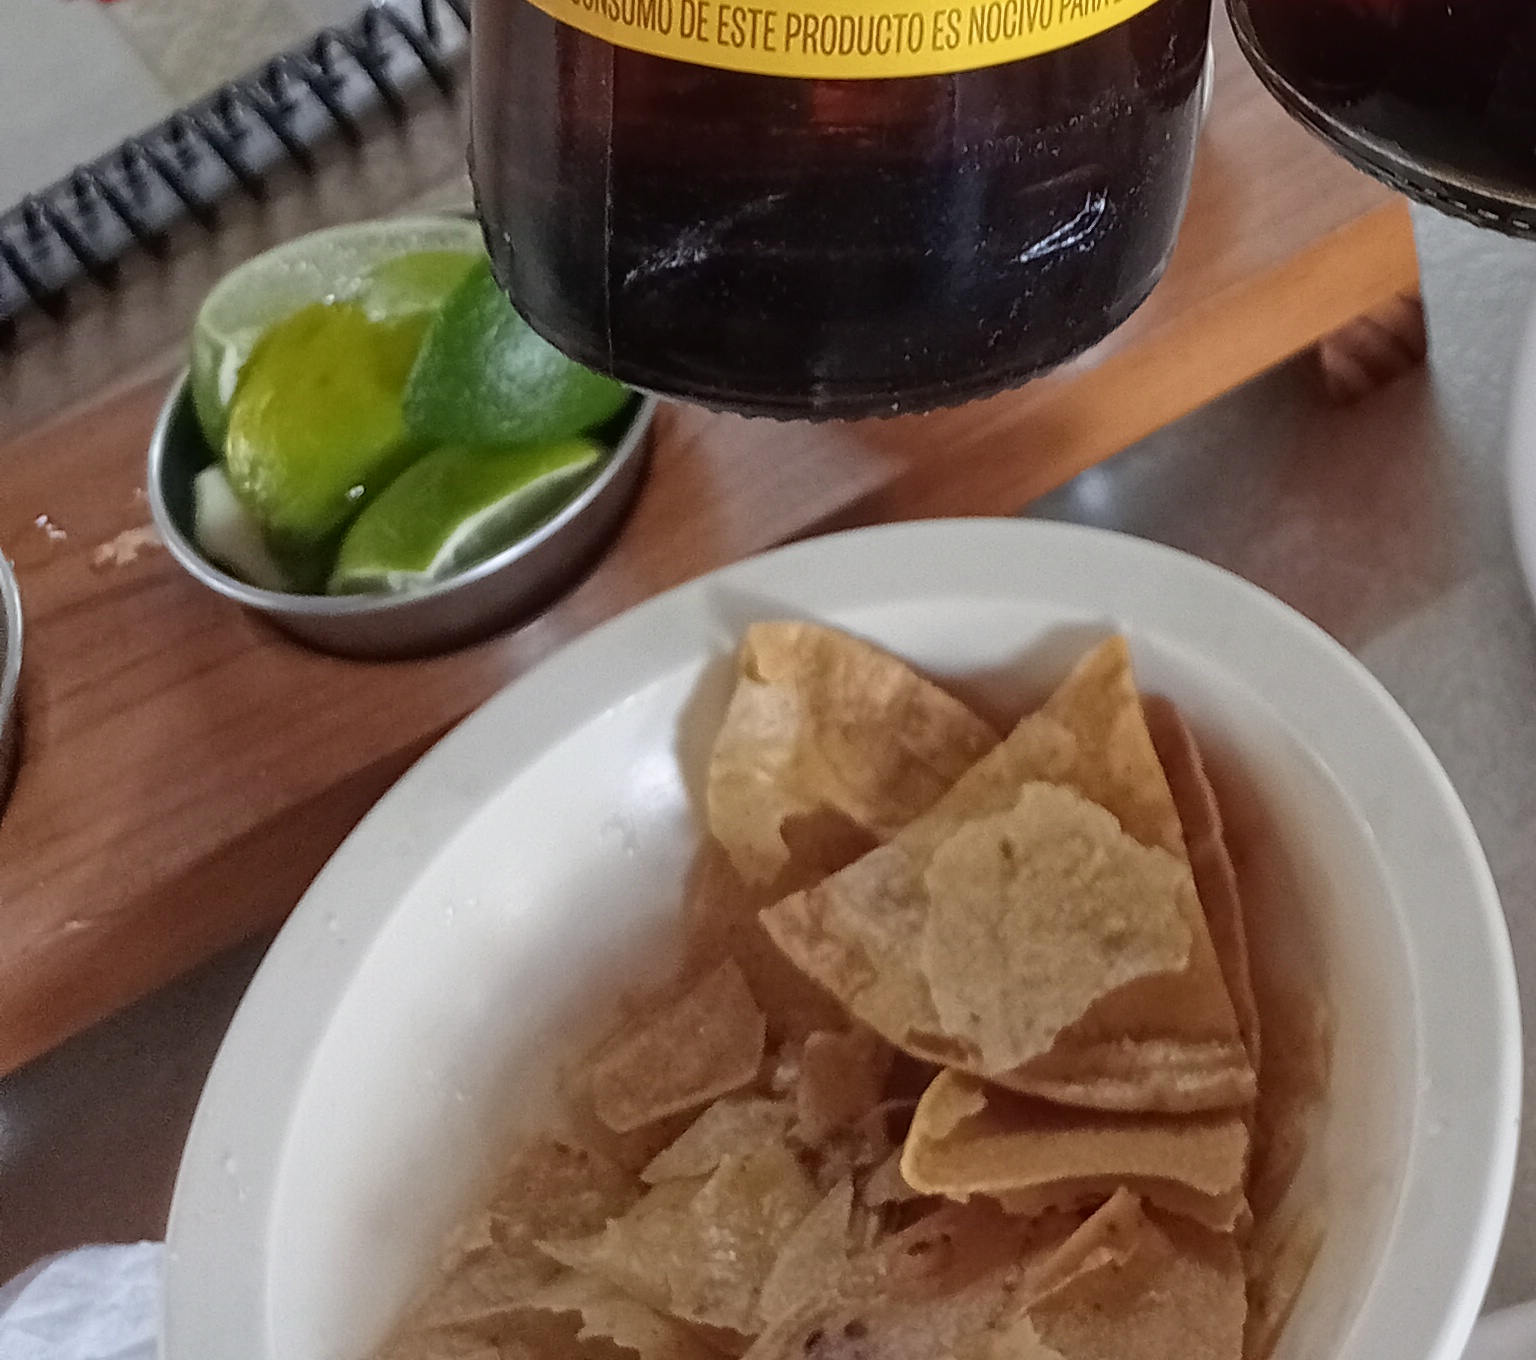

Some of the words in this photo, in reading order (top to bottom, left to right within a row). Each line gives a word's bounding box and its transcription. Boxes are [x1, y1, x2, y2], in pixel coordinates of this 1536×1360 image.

[717, 3, 778, 52] ESTE
[785, 11, 925, 56] PRODUCTO
[931, 7, 962, 51] ES
